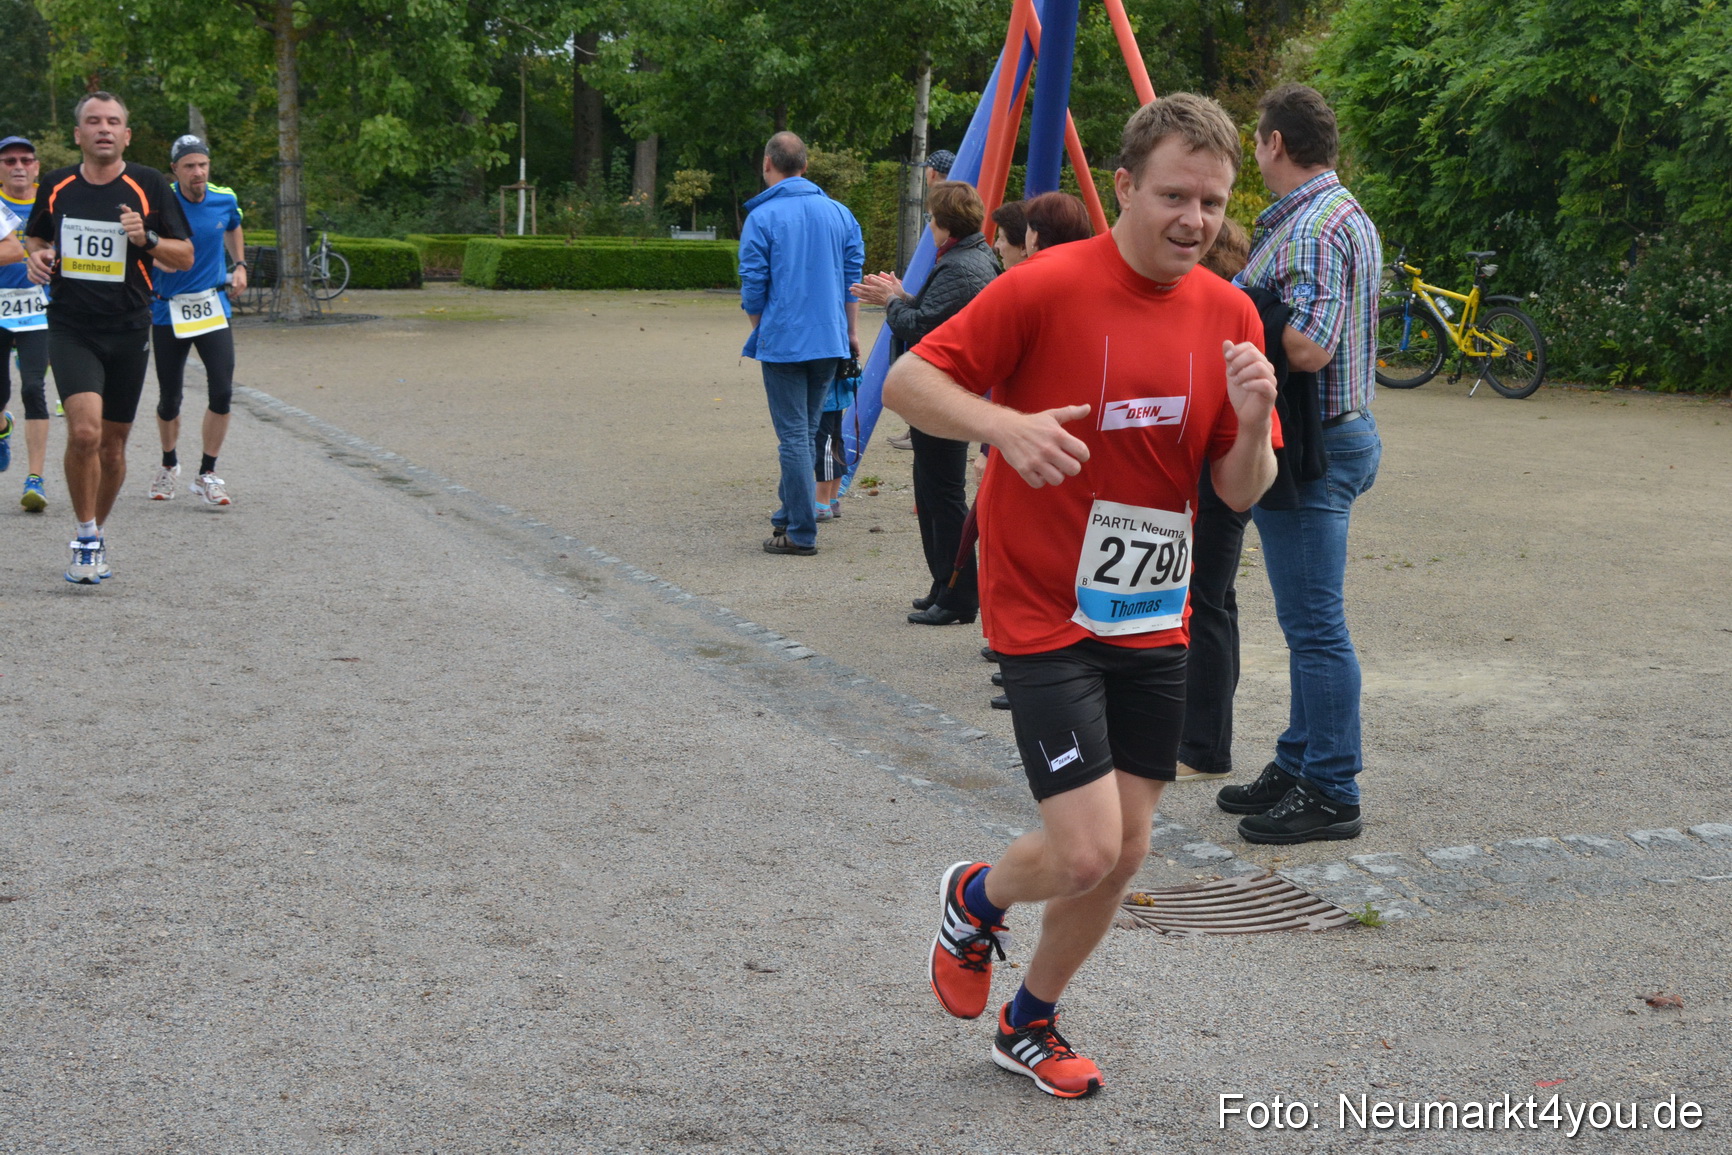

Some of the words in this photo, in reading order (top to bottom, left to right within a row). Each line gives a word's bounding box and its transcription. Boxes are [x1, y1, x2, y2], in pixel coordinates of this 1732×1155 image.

[84, 226, 117, 234] Neumarkt
[73, 234, 114, 258] 169
[72, 260, 111, 273] Bernhard
[1, 296, 45, 317] 2418
[181, 301, 213, 320] 638
[1125, 405, 1162, 420] DEHN
[1092, 513, 1137, 532] PARTL
[1093, 536, 1189, 588] 2790
[1081, 577, 1088, 586] B
[1110, 599, 1162, 618] Thomas
